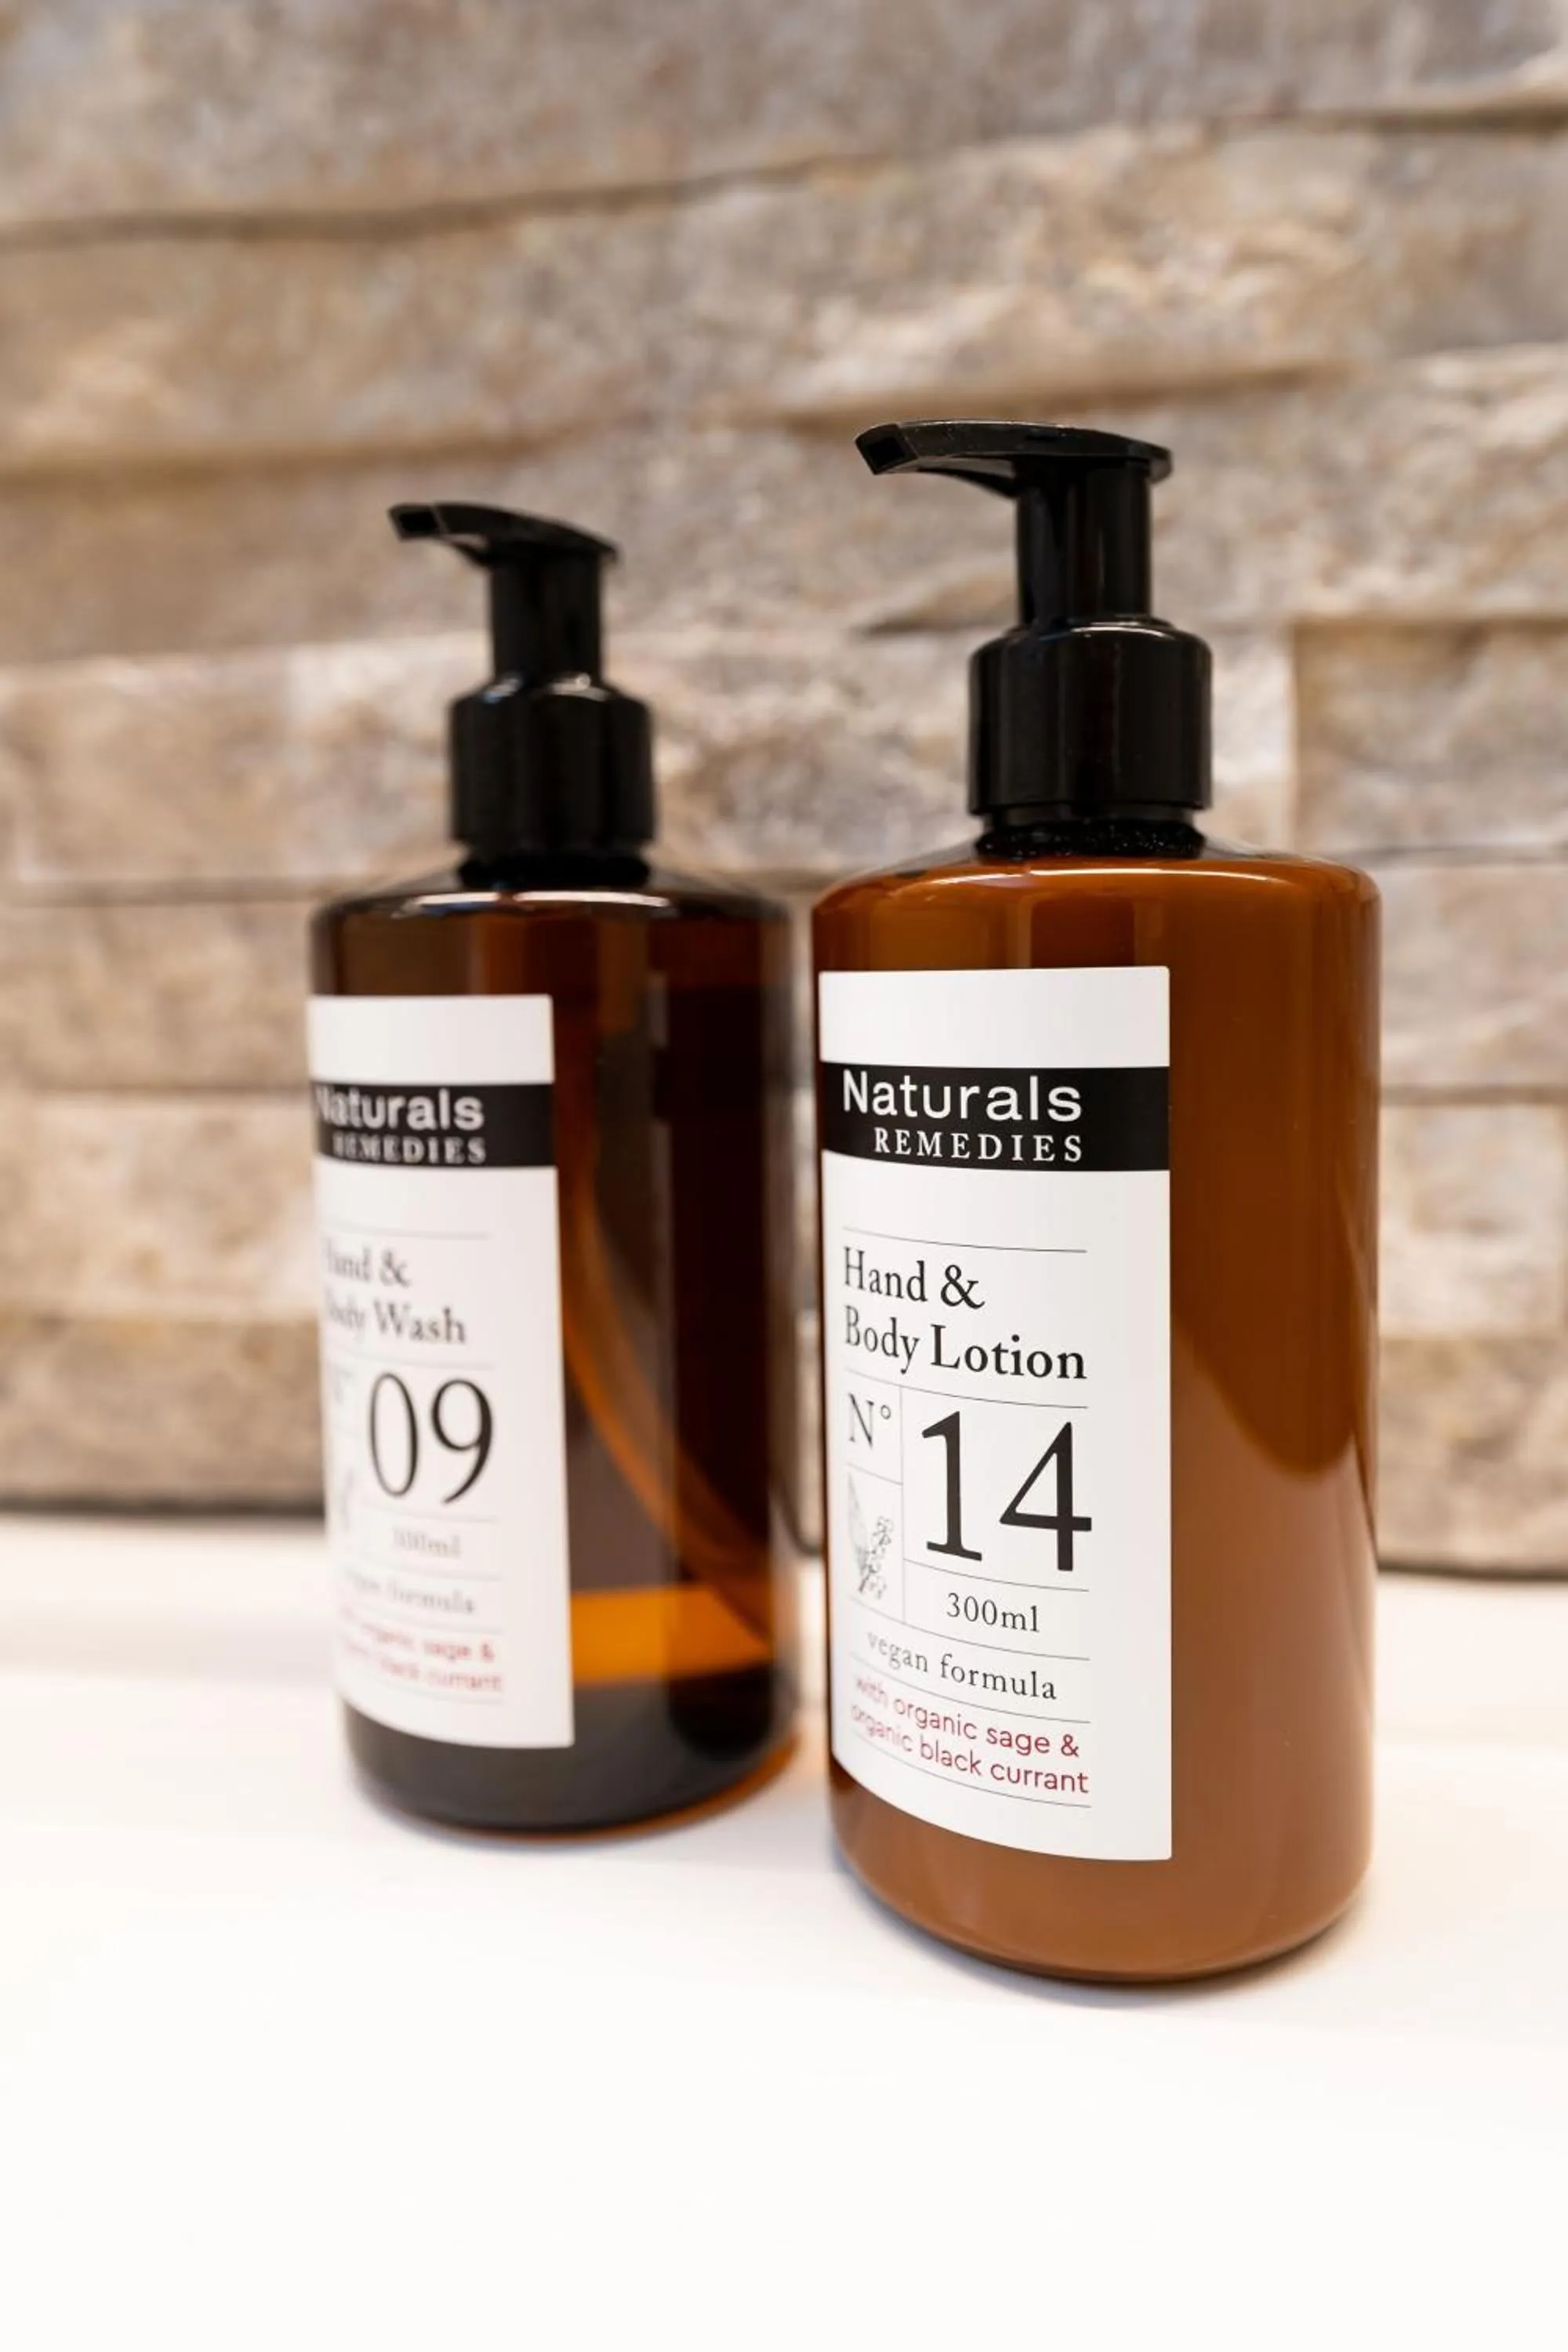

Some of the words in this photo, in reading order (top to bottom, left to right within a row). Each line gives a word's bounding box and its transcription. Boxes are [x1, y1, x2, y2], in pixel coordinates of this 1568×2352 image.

[843, 1069, 1083, 1122] Naturals
[874, 1127, 1083, 1162] REMEDIES
[379, 1250, 413, 1288] &
[844, 1247, 928, 1303] Hand
[940, 1265, 986, 1309] &
[373, 1299, 467, 1344] Wash
[844, 1305, 920, 1374] Body
[931, 1324, 1087, 1380] Lotion
[369, 1372, 493, 1504] 09
[921, 1410, 1092, 1572] 14
[946, 1592, 1040, 1634] 300ml
[867, 1631, 928, 1672] vegan
[940, 1653, 1057, 1700] formula
[854, 1674, 889, 1708] with
[894, 1696, 978, 1740] organic
[985, 1726, 1051, 1756] sage
[1061, 1734, 1080, 1758] &
[920, 1734, 982, 1777] black
[990, 1762, 1089, 1794] currant
